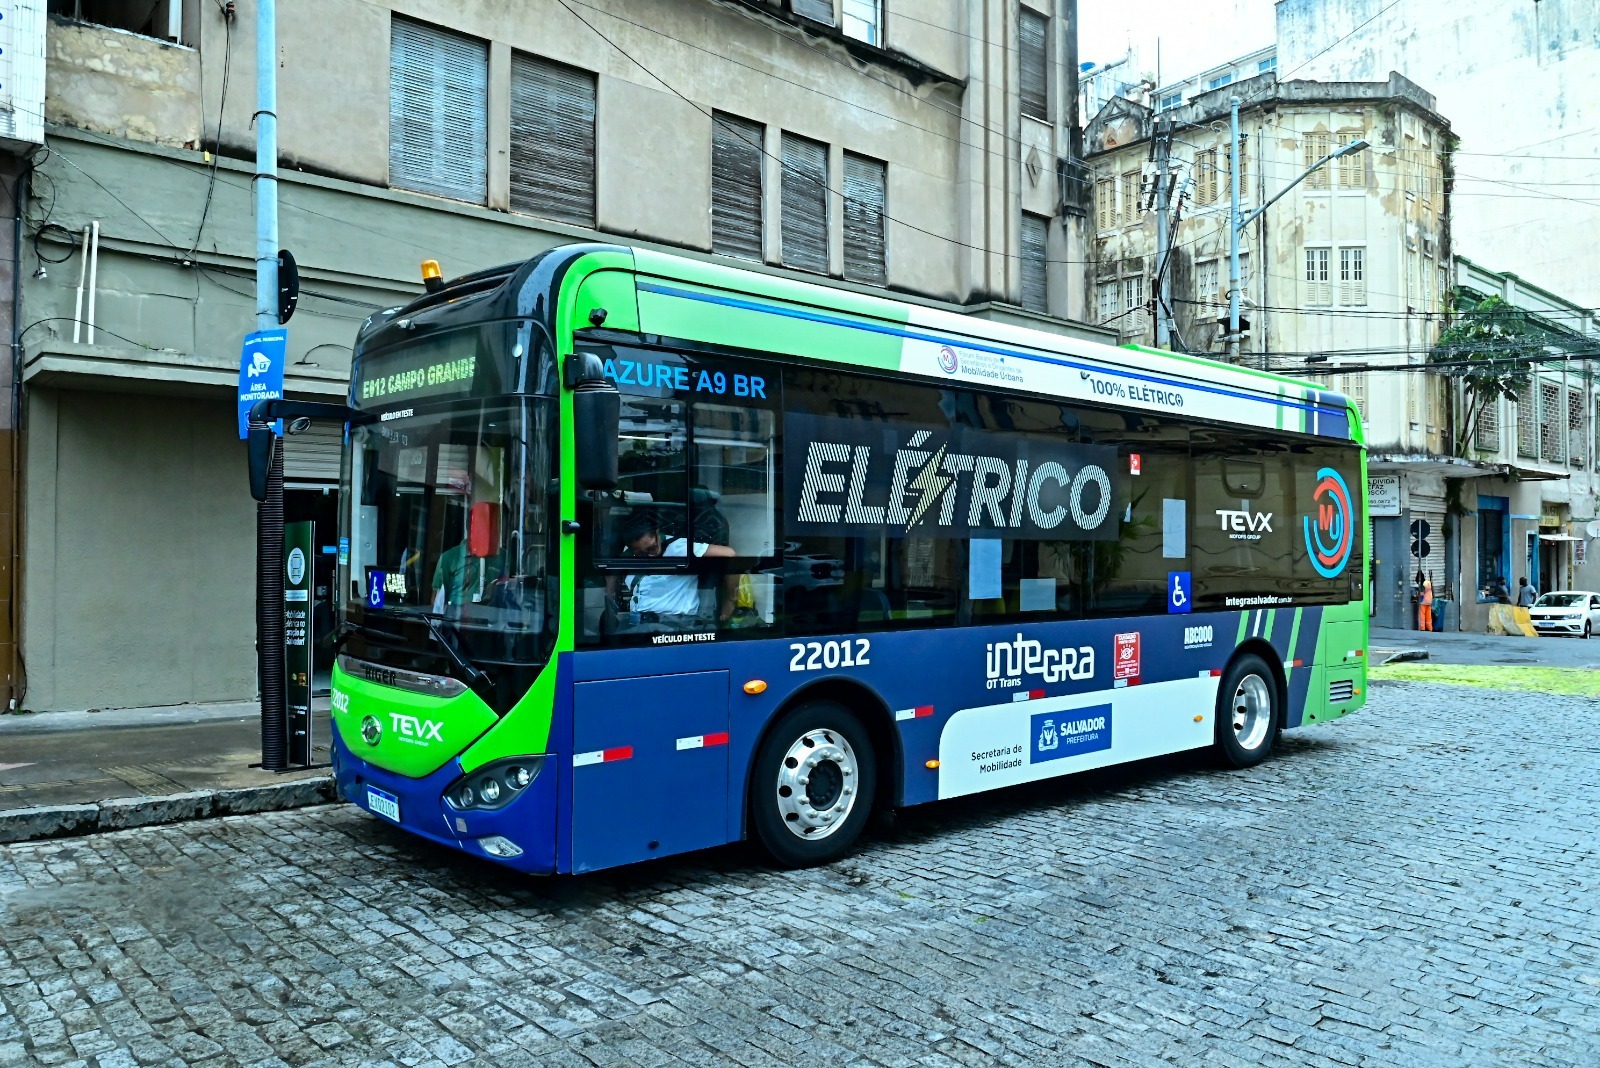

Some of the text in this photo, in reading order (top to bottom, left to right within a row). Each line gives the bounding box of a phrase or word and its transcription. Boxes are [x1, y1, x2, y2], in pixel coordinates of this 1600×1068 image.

[387, 368, 426, 394] CAMPO
[427, 356, 477, 386] GRANDE
[604, 358, 767, 399] AZURE A9 BR
[961, 365, 1024, 383] Mobilidade Urbana
[240, 382, 280, 401] ÁREA MONITORADA
[1090, 378, 1184, 407] 100% ELÉTRICO
[797, 430, 1112, 531] ELÉTRICO
[1215, 509, 1273, 533] TEVX
[652, 632, 716, 644] VEÍCULO EM TESTE
[789, 638, 870, 672] 22012
[365, 665, 397, 687] HIGER
[986, 678, 1022, 690] OT Trans
[389, 712, 444, 742] TEVX
[1060, 716, 1106, 737] SALVADOR
[1066, 732, 1099, 745] PREFEITURA
[971, 744, 1023, 762] Secretaria de
[979, 758, 1022, 774] Mobilidade
